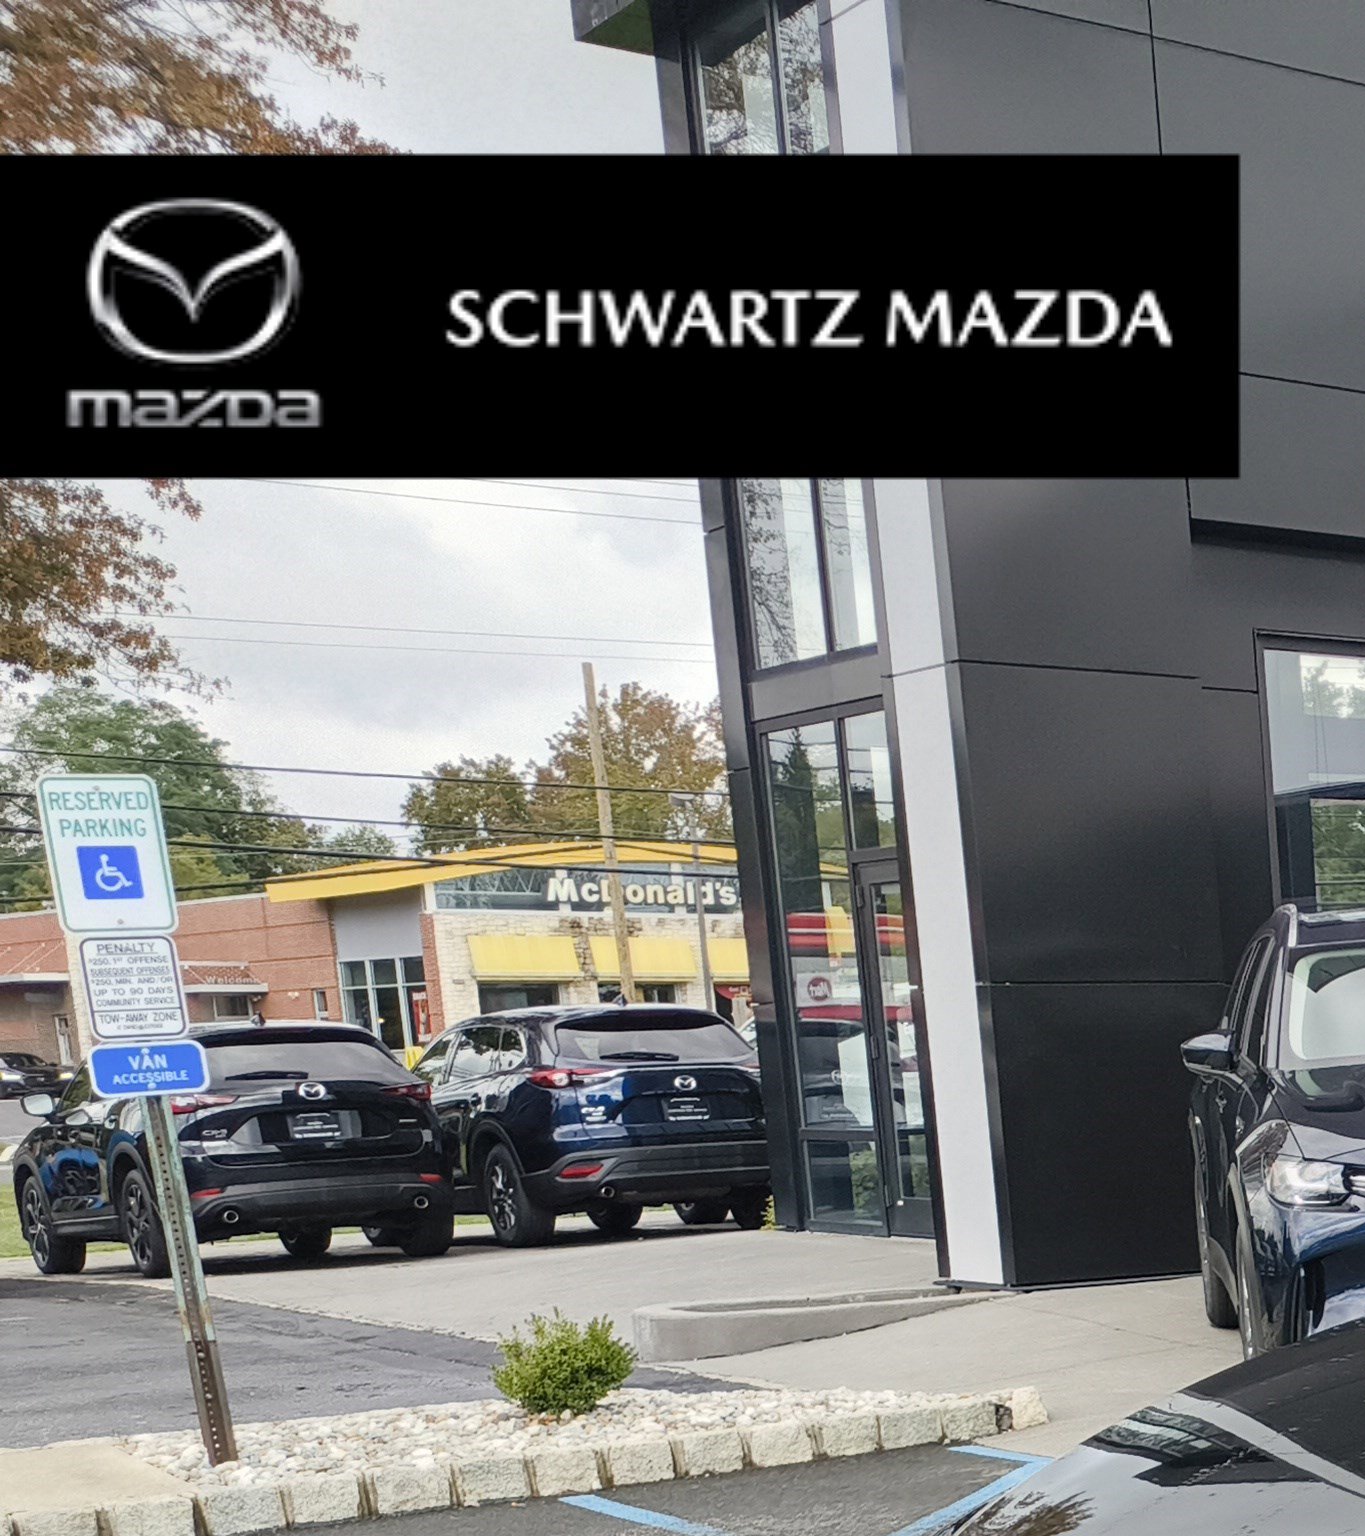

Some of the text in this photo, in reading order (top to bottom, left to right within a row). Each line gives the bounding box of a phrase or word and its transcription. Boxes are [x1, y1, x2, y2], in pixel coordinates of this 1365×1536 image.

[48, 791, 149, 811] RESERVED
[59, 818, 147, 837] PARKING
[97, 942, 155, 953] PENALTY
[127, 955, 168, 964] OFFENSE
[94, 986, 173, 997] UP TO 90 DAYS
[96, 996, 175, 1007] COMMUNITY SERVICE
[98, 1011, 178, 1024] TOW-AWAY ZONE
[128, 1054, 168, 1070] VAN
[112, 1070, 189, 1085] ACCESSIBLE
